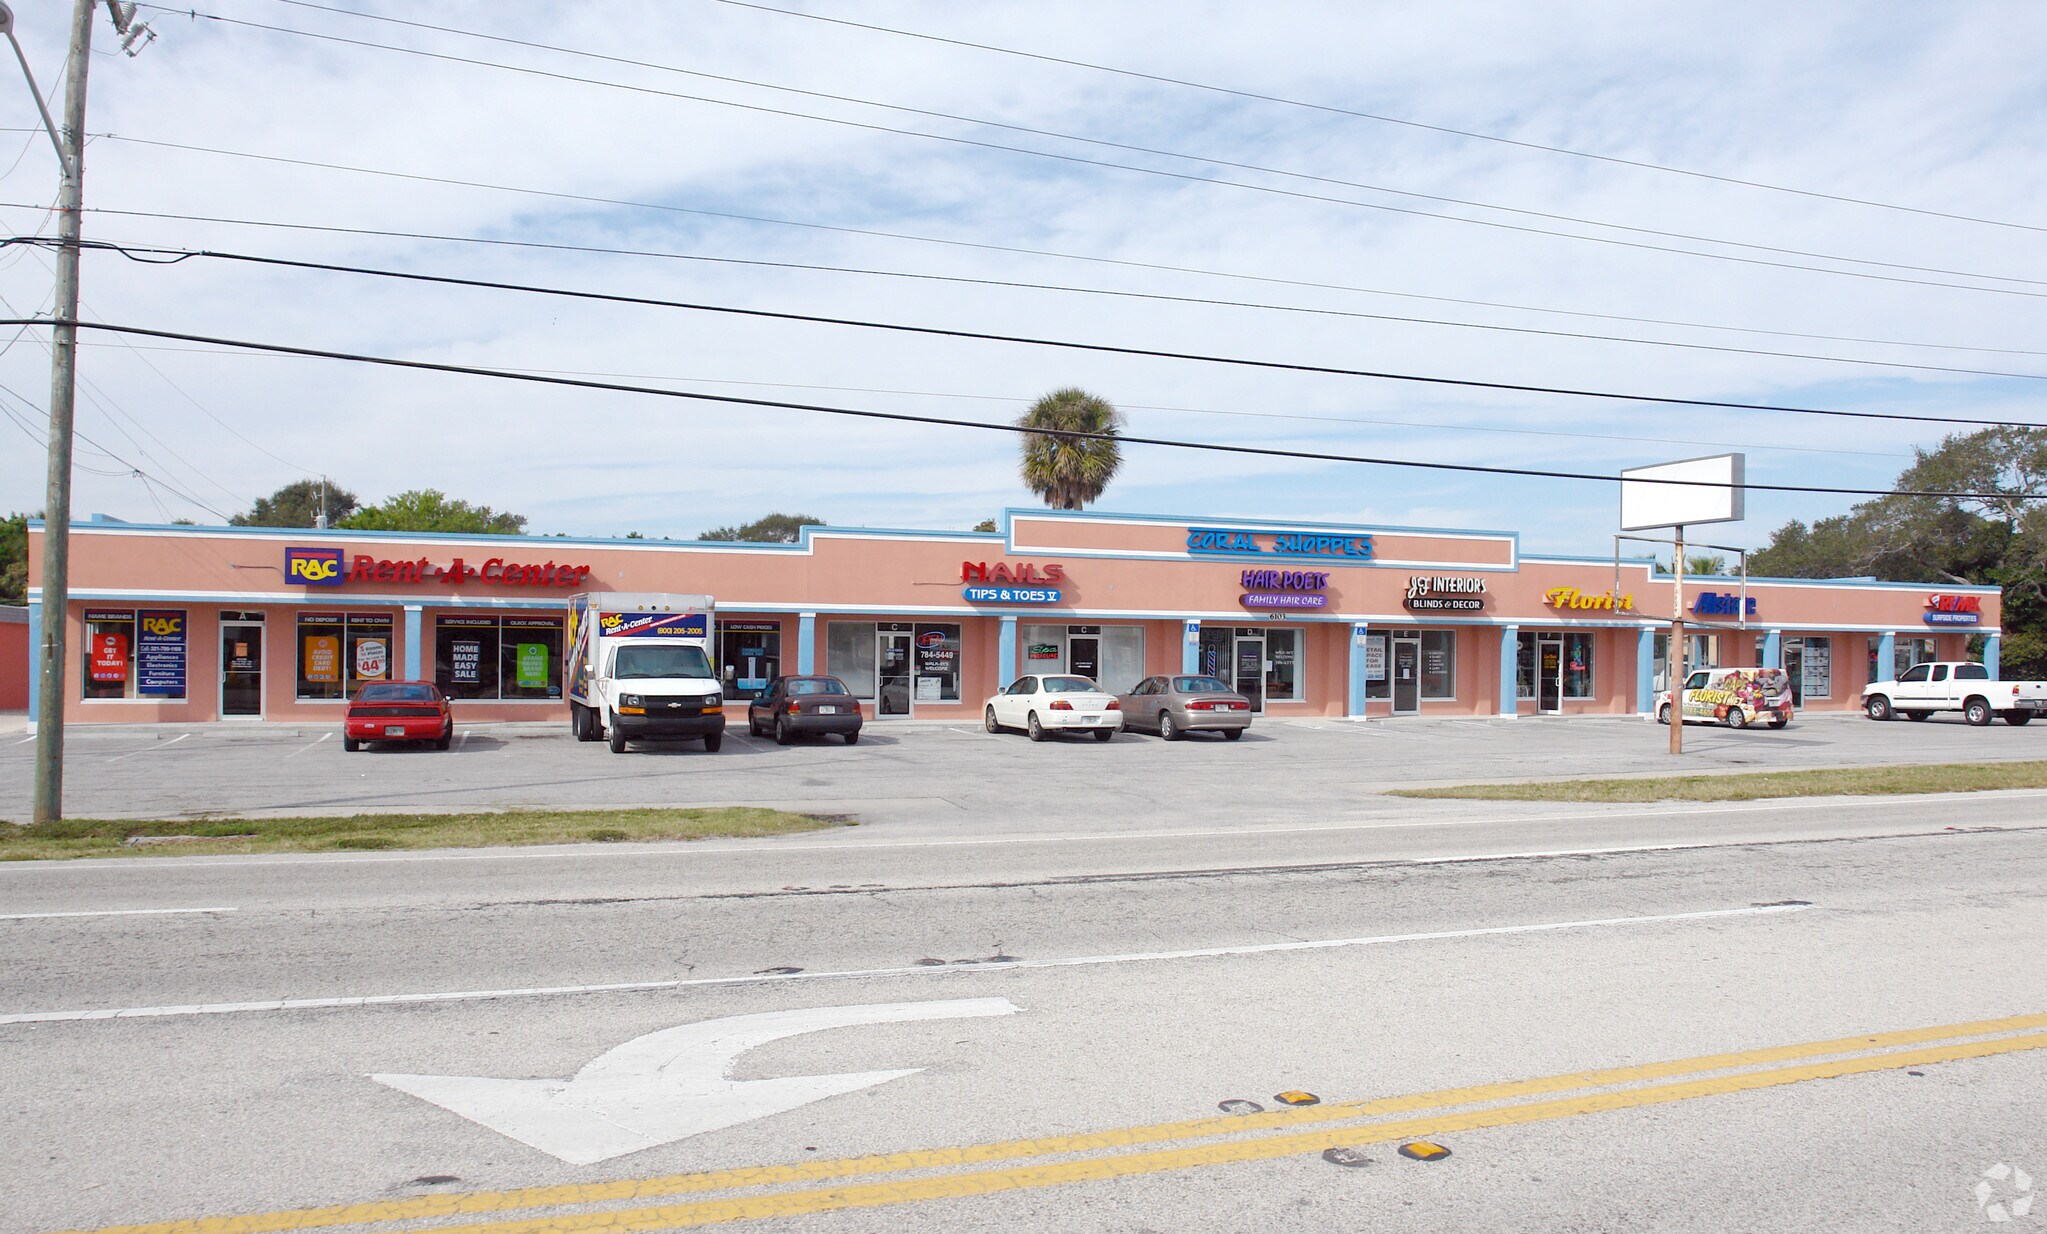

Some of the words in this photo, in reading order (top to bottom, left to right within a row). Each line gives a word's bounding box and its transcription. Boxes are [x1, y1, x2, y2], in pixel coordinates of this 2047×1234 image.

[1187, 531, 1261, 551] CORAL
[1273, 533, 1374, 556] SHOPPES
[290, 558, 338, 580] RAC
[962, 561, 1065, 585] NAILS
[1242, 569, 1281, 590] HAIR
[1282, 571, 1330, 591] POETS
[1432, 576, 1487, 594] INTERIORS
[970, 588, 998, 600] TIPS
[1000, 589, 1011, 600] &
[1013, 590, 1046, 601] TOES
[1249, 595, 1279, 605] FAMILY
[1280, 596, 1301, 605] HAIR
[1302, 596, 1323, 606] CARE
[1413, 599, 1443, 608] BLINDS
[1444, 601, 1452, 609] &
[1452, 600, 1481, 610] DECOR
[238, 611, 247, 620] A
[600, 613, 624, 628] RAC
[143, 617, 182, 636] RAC
[891, 623, 898, 631] C
[1080, 626, 1087, 634] C
[1247, 628, 1253, 636] D
[1403, 630, 1409, 638] E
[1546, 632, 1552, 640] F
[453, 645, 479, 653] HOME
[1031, 645, 1058, 654] Spa
[453, 653, 479, 661] MADE
[920, 651, 954, 659] 784-5449
[454, 670, 476, 678] SALE
[1724, 678, 1748, 692] CAPE
[1688, 688, 1732, 705] FLORIST
